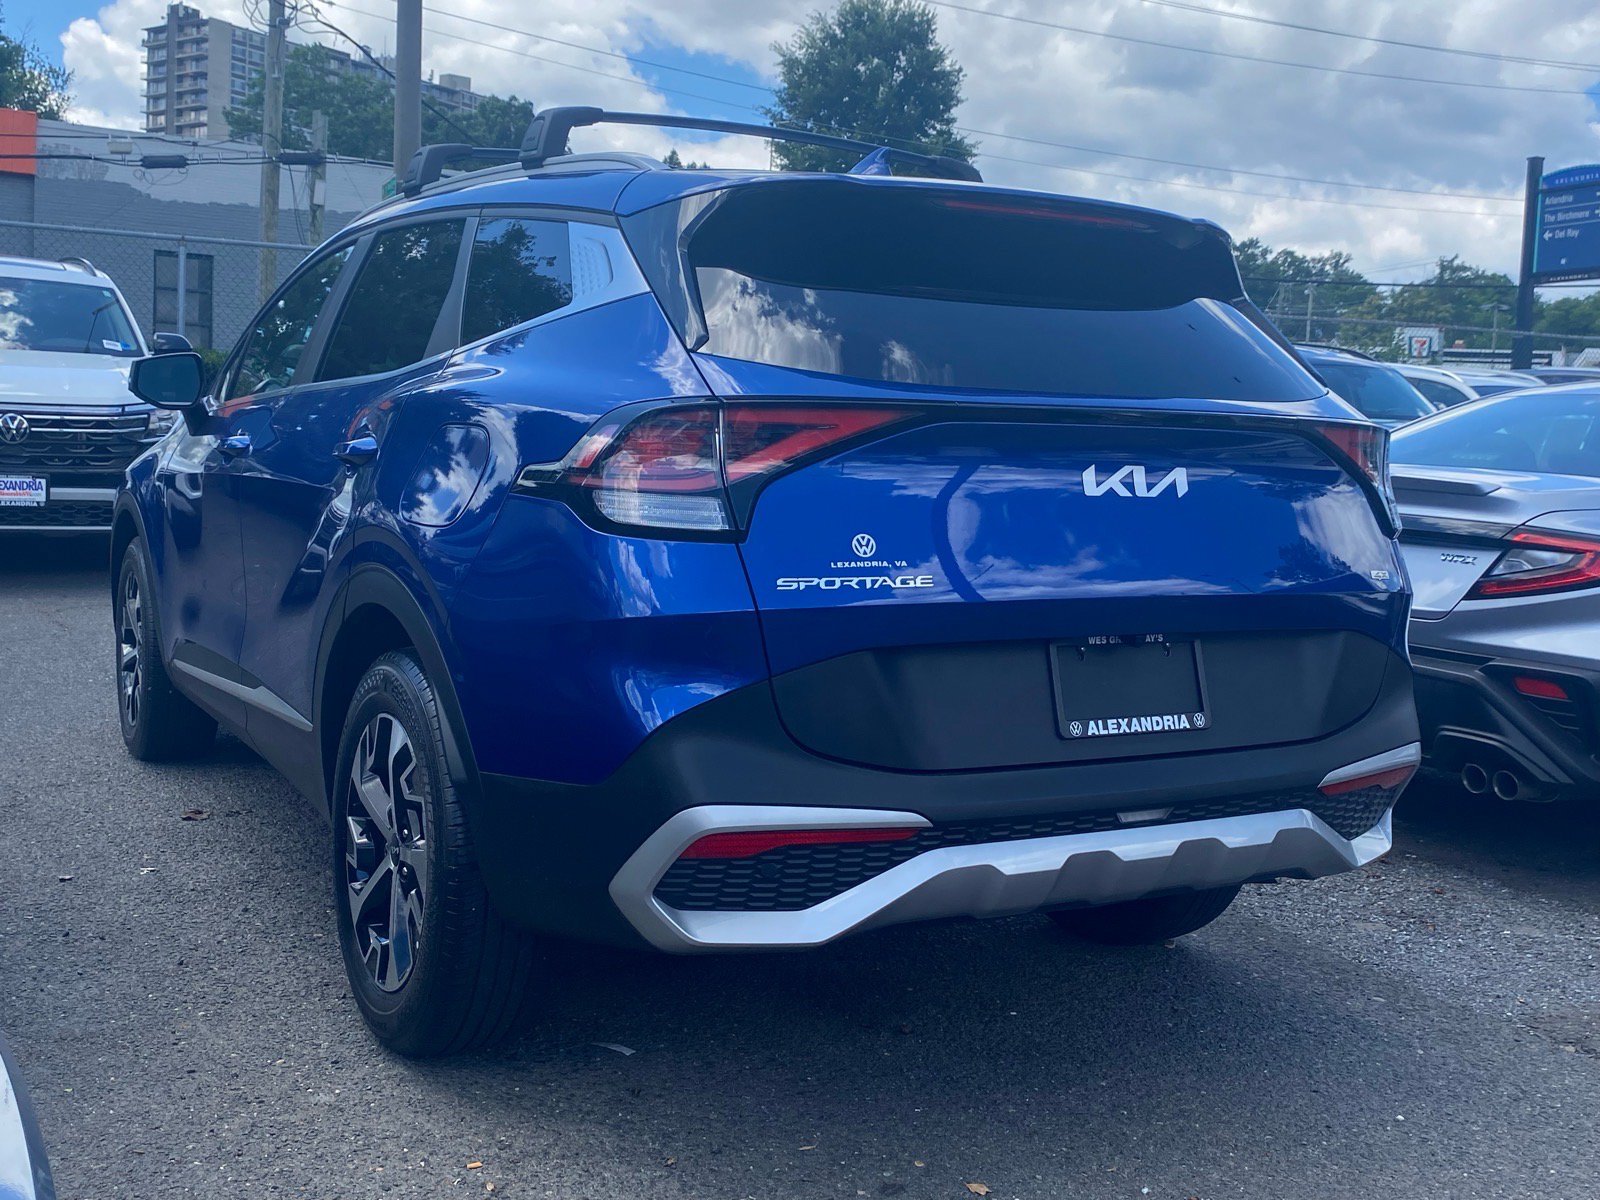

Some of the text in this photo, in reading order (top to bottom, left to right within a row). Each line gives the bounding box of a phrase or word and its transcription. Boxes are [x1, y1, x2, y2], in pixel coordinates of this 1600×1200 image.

[1082, 463, 1189, 498] KIA
[1440, 553, 1477, 565] WRX
[776, 575, 935, 591] SPORTAGE
[1088, 636, 1107, 645] WES
[1087, 714, 1191, 736] ALEXANDRIA
